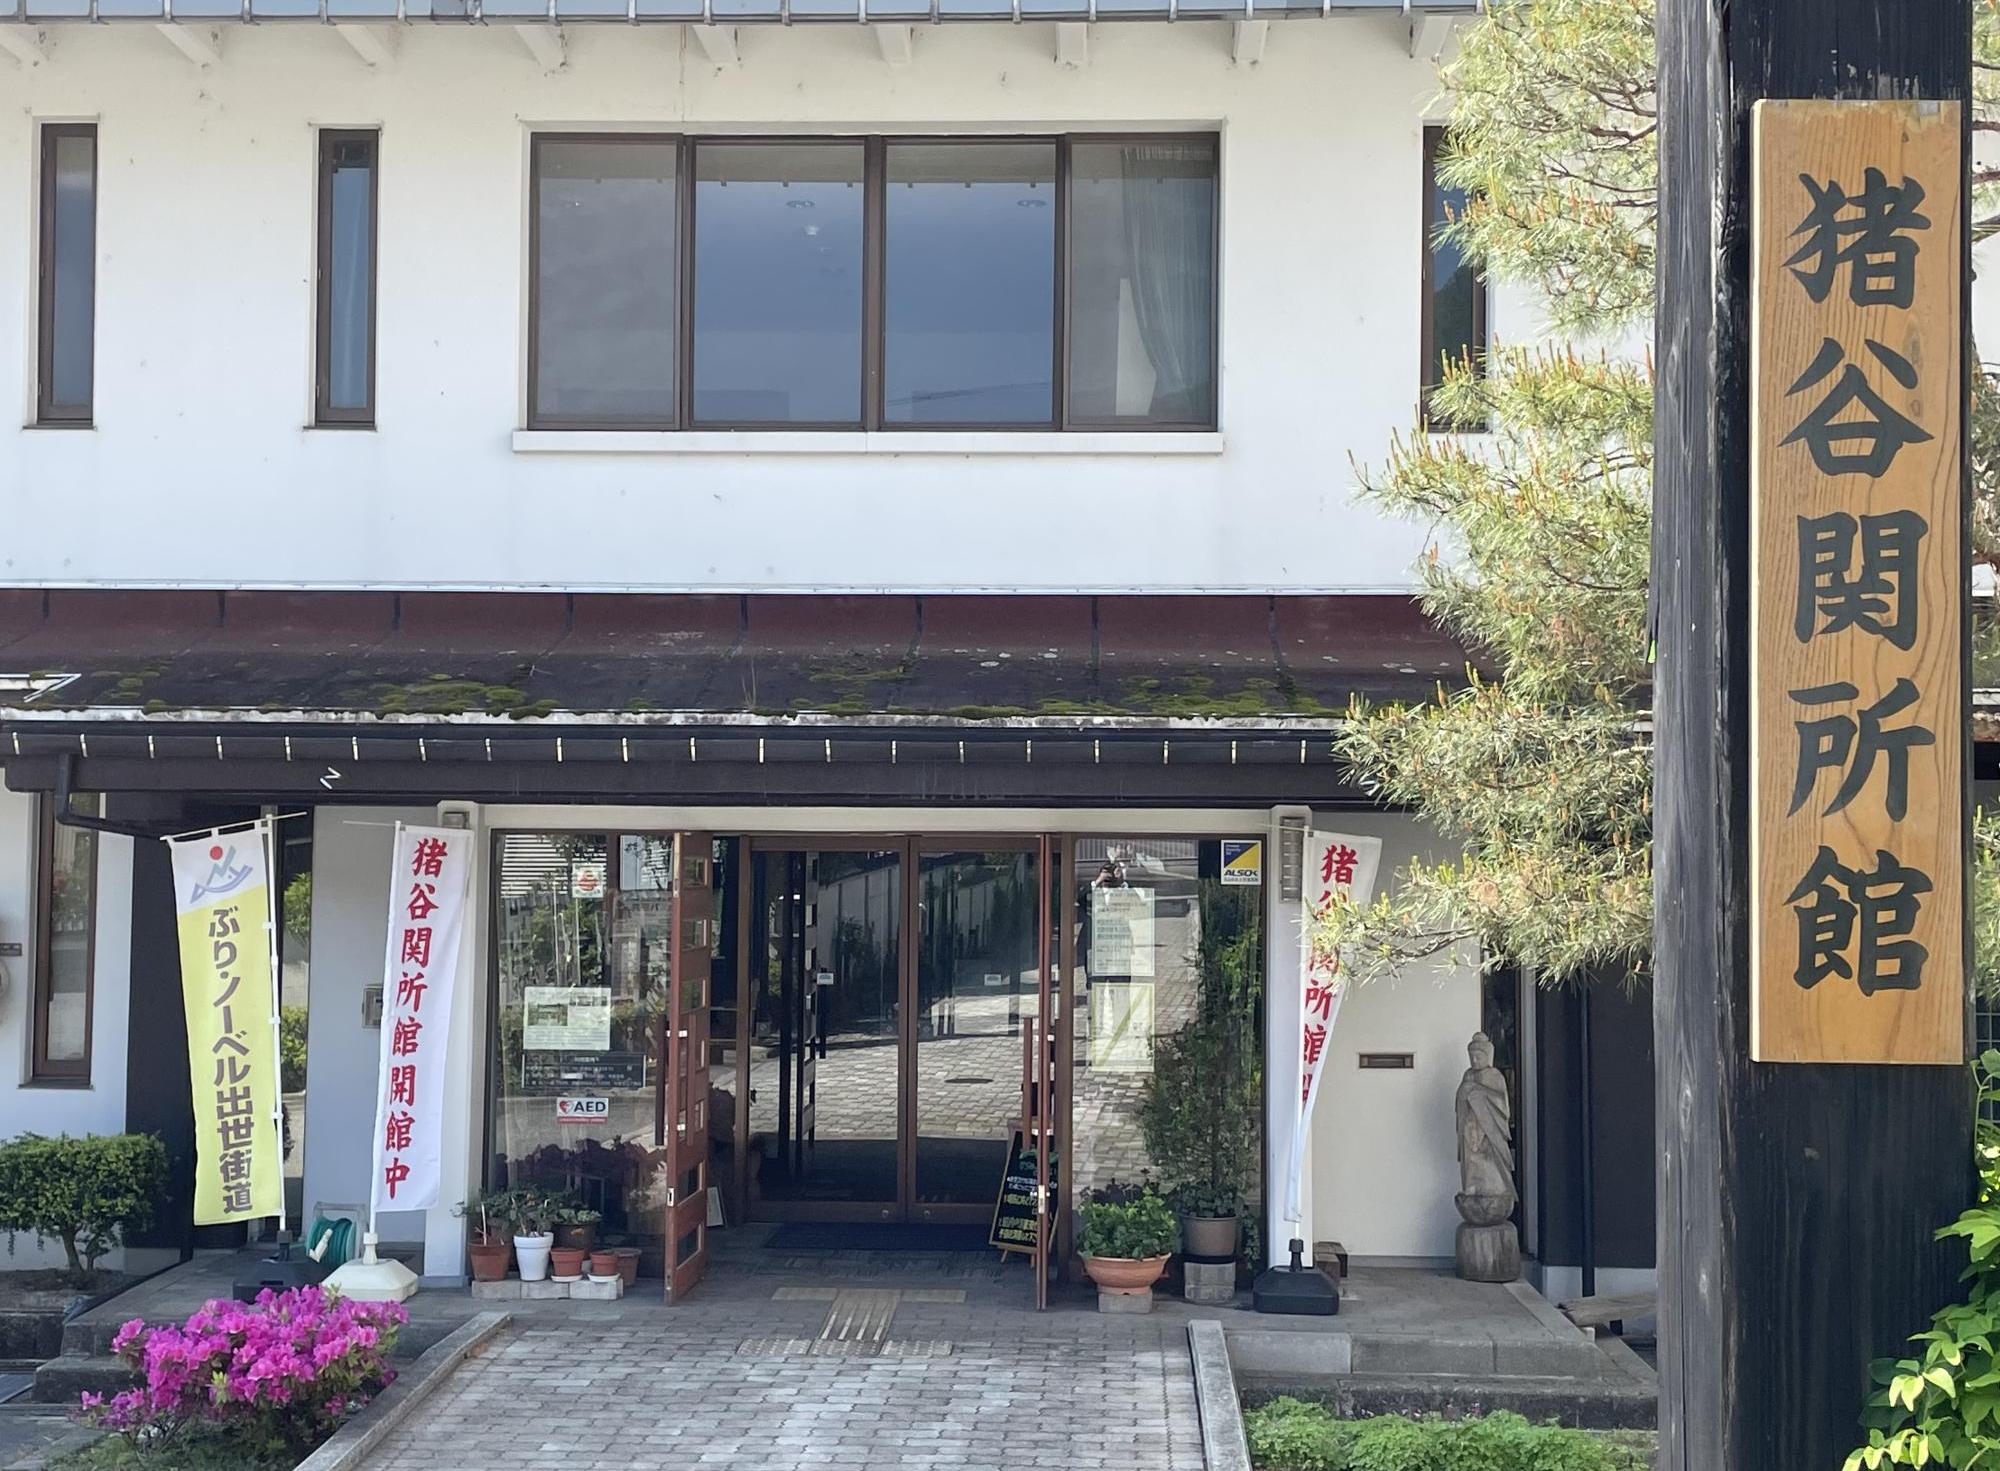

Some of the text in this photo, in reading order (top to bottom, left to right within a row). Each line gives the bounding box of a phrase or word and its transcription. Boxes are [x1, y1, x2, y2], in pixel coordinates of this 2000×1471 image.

[1776, 165, 1936, 998] 猪谷関所館
[384, 838, 449, 1200] 猪谷関所館開館中
[573, 1101, 606, 1113] AED
